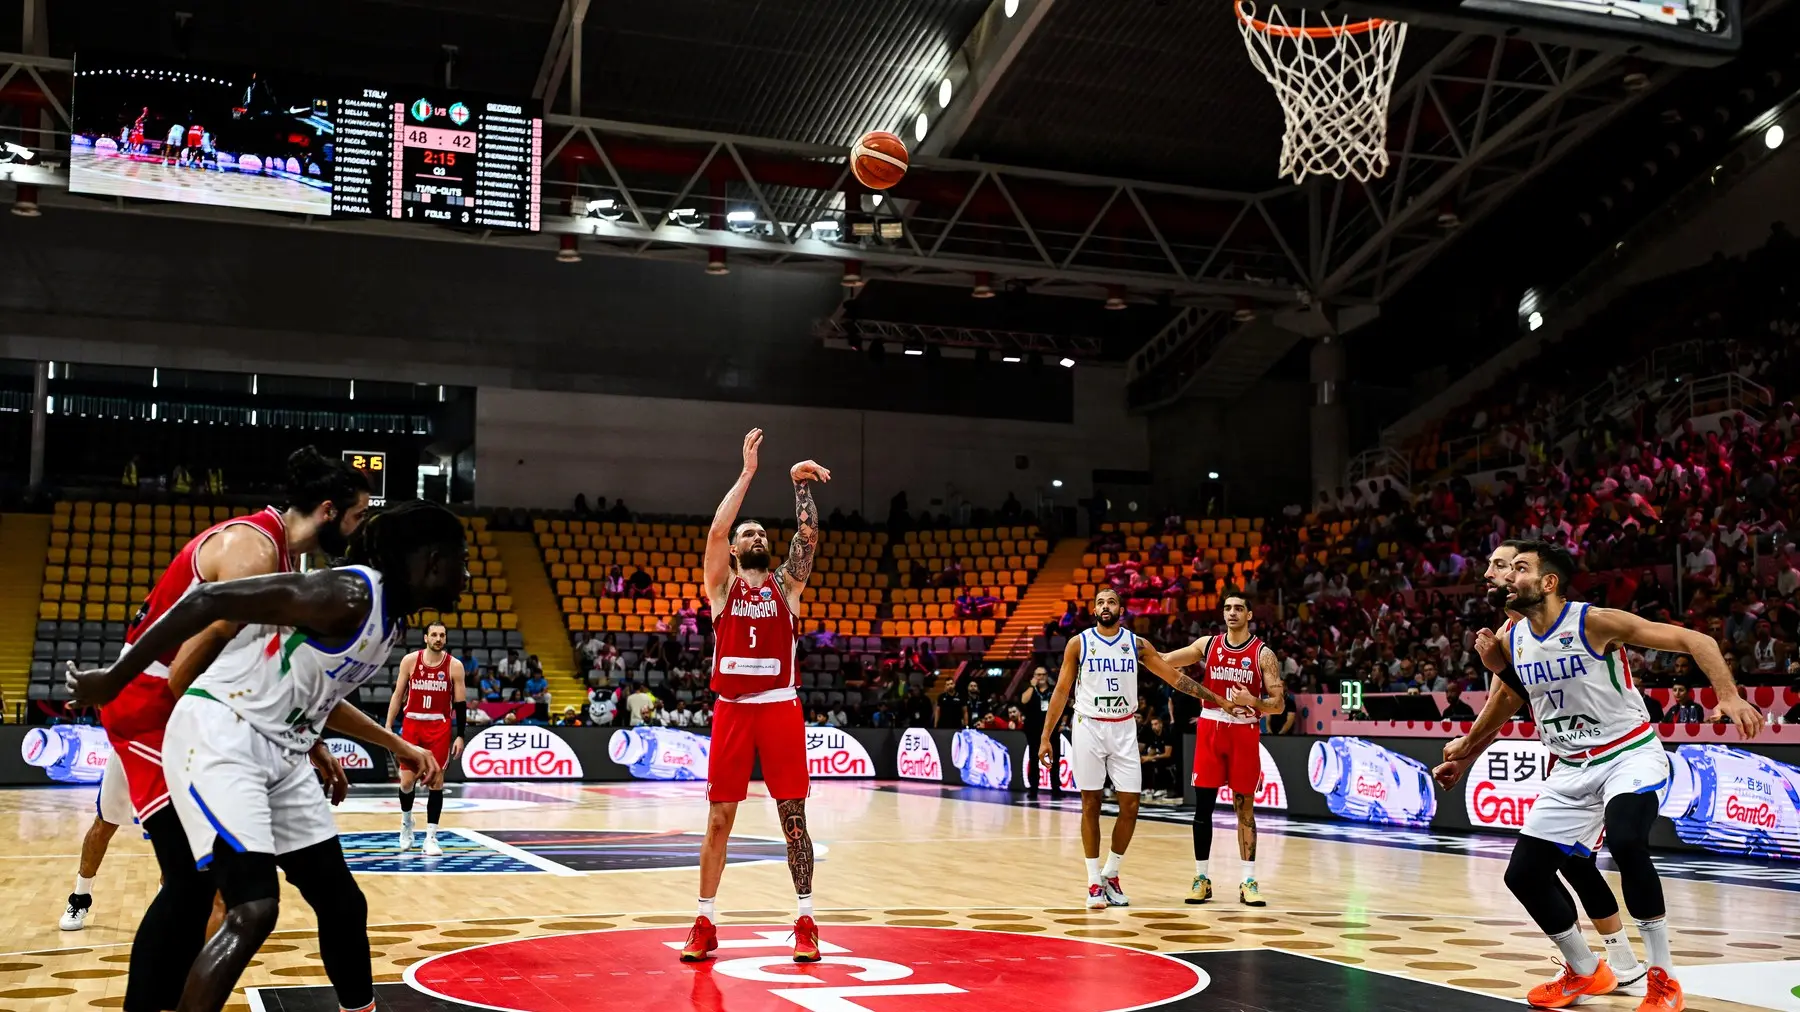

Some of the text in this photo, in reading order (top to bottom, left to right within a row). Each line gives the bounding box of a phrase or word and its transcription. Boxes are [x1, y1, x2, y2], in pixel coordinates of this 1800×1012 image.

[363, 89, 387, 99] ITALY
[434, 107, 447, 116] VS
[409, 130, 427, 143] 48
[452, 135, 471, 148] 42
[424, 150, 456, 166] 2:15
[433, 167, 446, 176] Q3
[407, 206, 469, 223] 1 FOULS 3
[749, 626, 757, 648] 5
[1088, 658, 1135, 673] ITALIA
[1517, 655, 1587, 685] ITALIA
[1106, 678, 1119, 691] 15
[422, 695, 432, 709] 10
[1094, 696, 1129, 706] ITA
[1341, 681, 1361, 709] 33
[1545, 689, 1564, 709] 17
[485, 733, 549, 750] 百岁山
[905, 735, 929, 751] 百岁山
[1549, 728, 1601, 744] AIRWAYS
[1747, 777, 1772, 796] 百岁山
